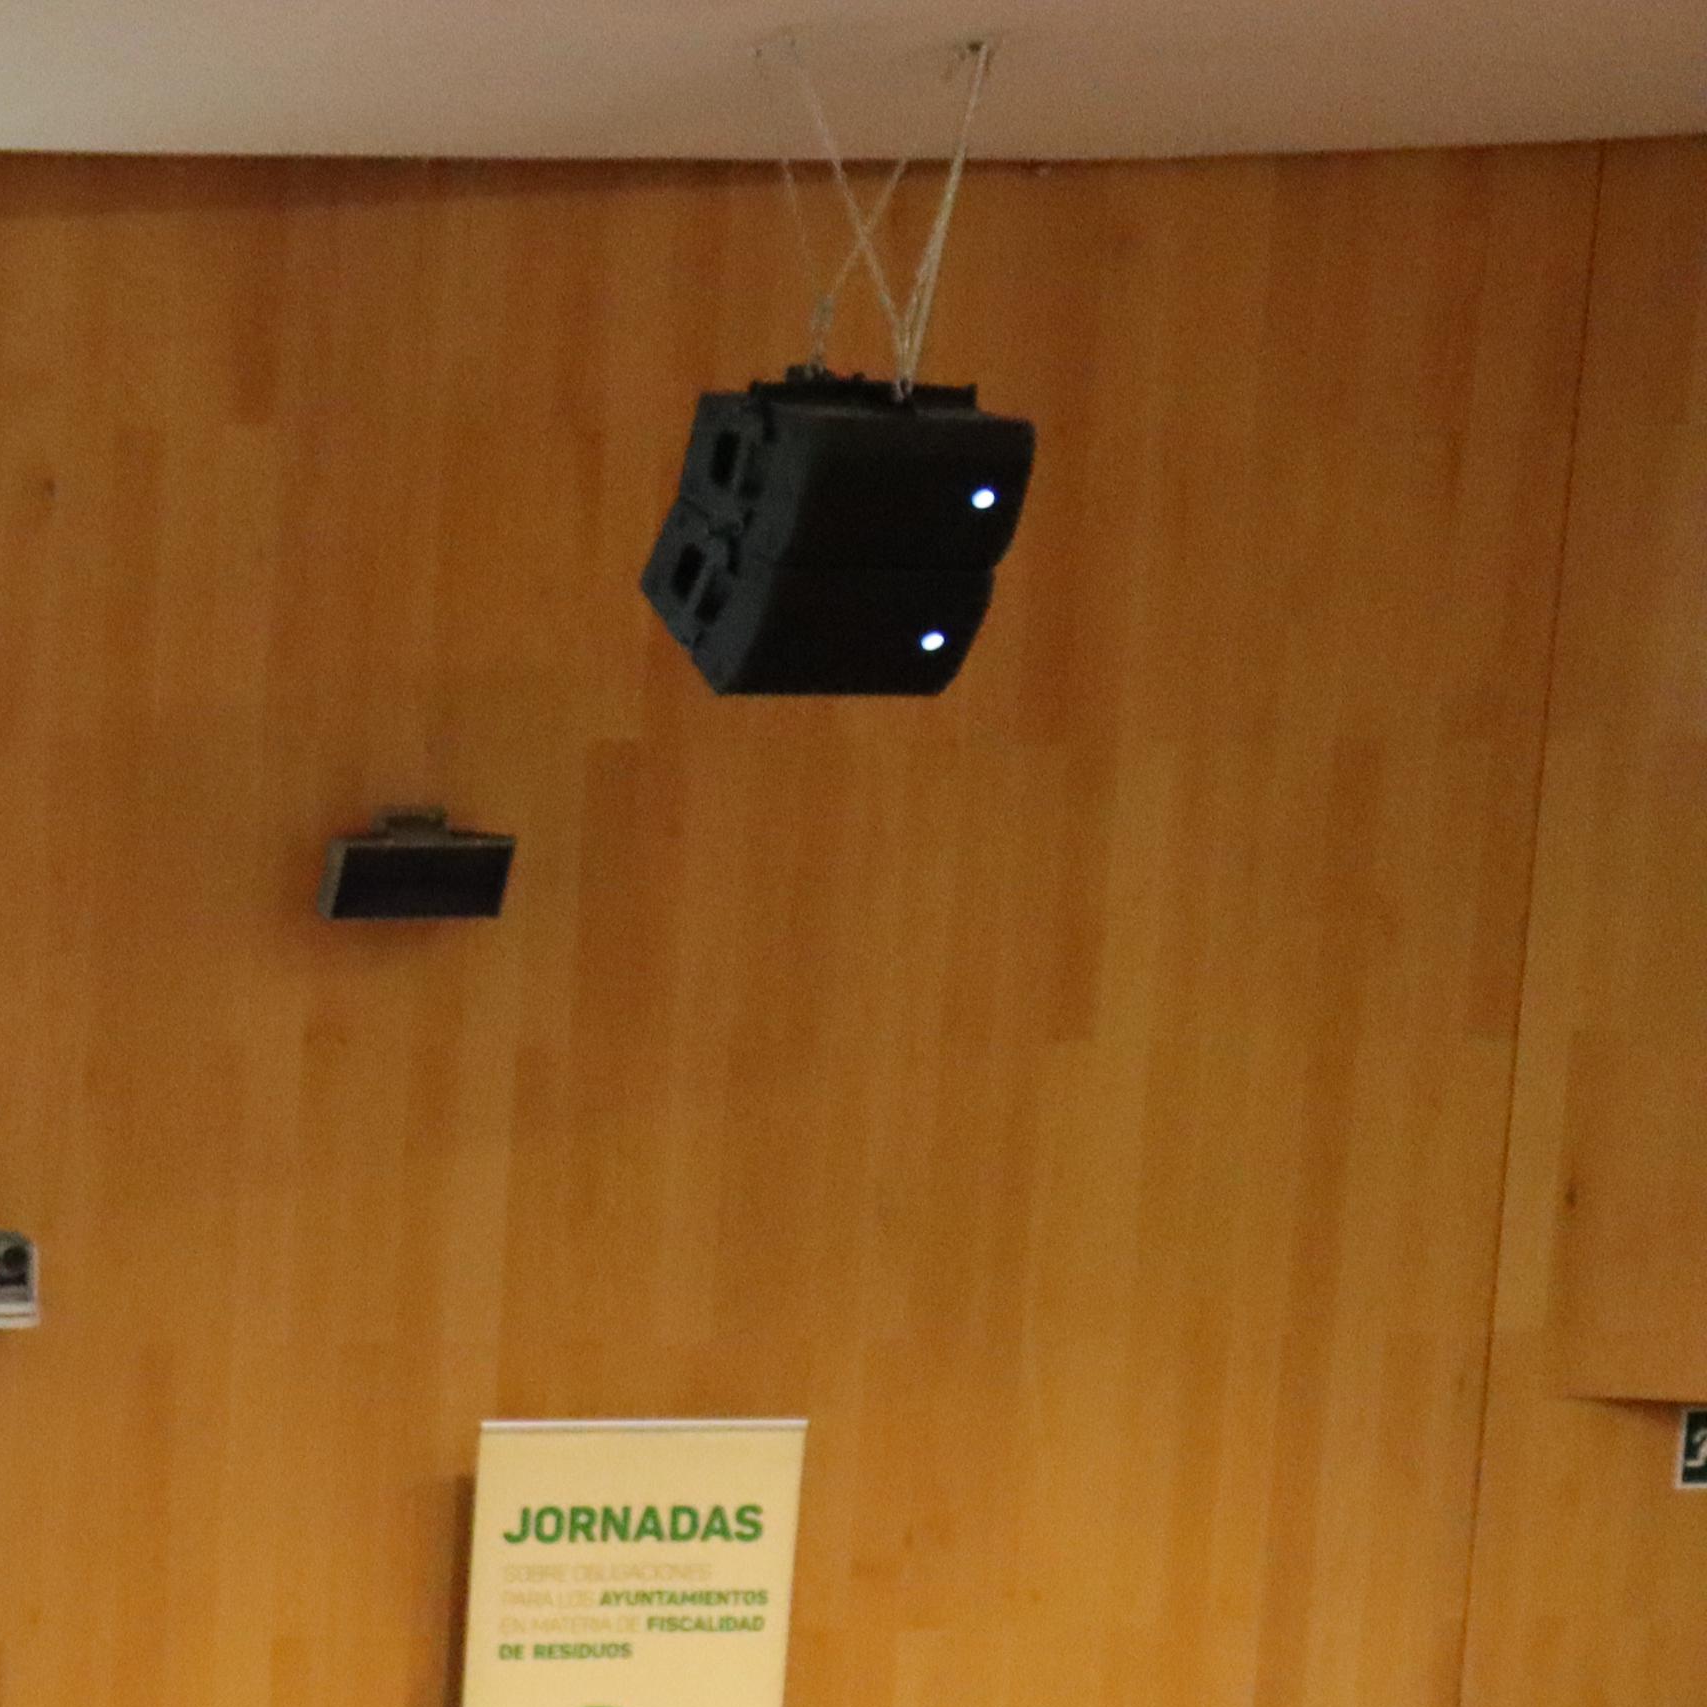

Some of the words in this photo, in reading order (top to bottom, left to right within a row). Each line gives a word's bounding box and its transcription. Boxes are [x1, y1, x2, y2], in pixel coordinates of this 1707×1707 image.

[503, 1504, 764, 1544] JORNADAS
[599, 1589, 768, 1607] AYUNTAMIENTOS
[647, 1615, 765, 1632] FISCALIDAD
[499, 1643, 524, 1660] DE
[533, 1642, 633, 1660] RESIDUOS
